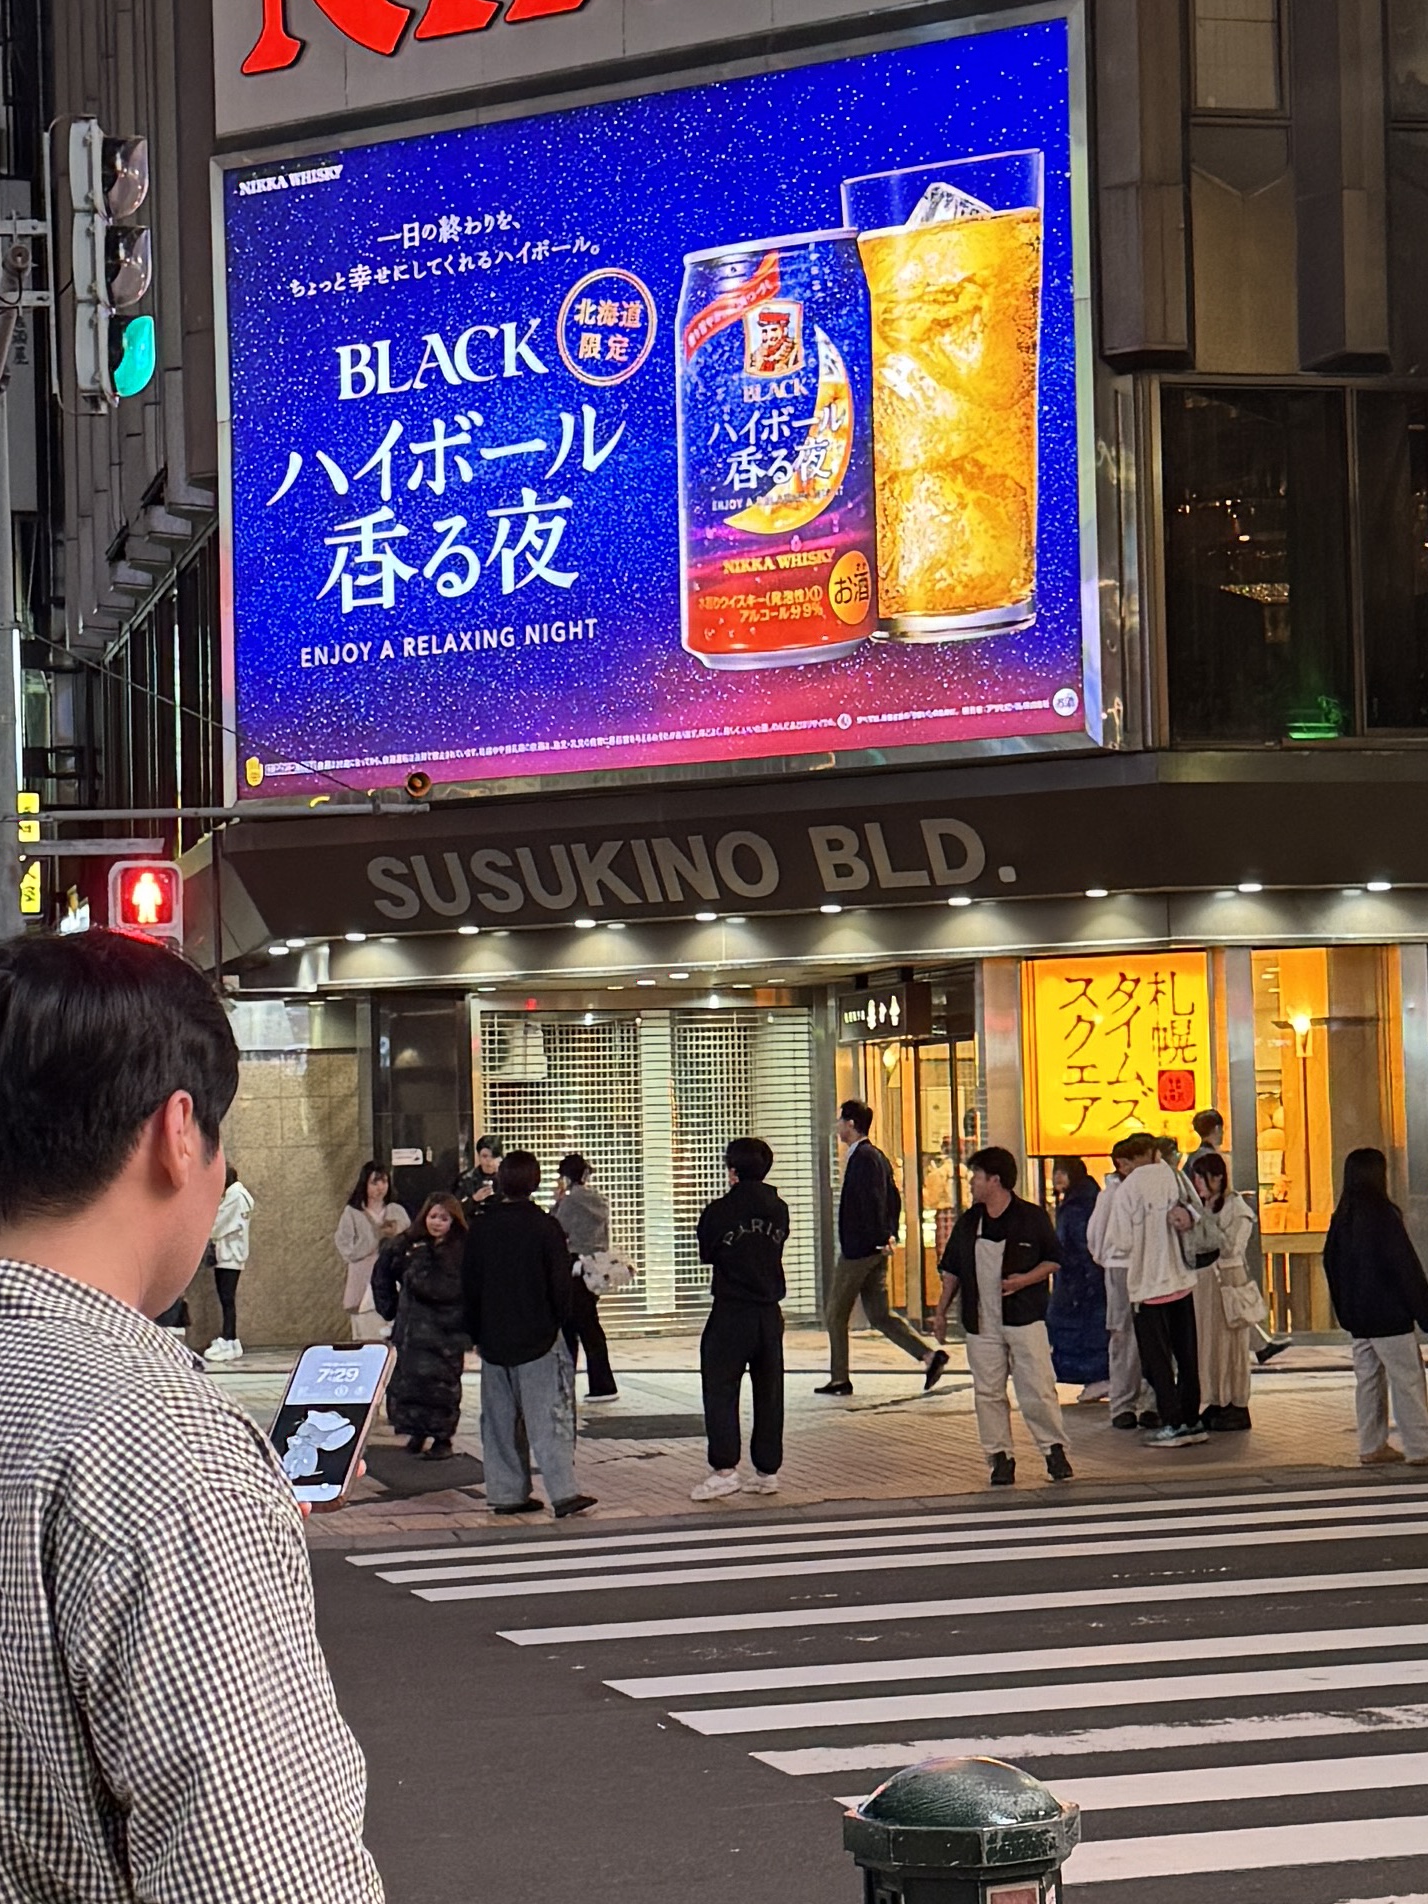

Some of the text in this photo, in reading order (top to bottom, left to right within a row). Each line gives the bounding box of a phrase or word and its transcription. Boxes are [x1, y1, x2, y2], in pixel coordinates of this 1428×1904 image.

[239, 164, 344, 196] NIKKA WHISKY
[376, 209, 521, 249] 一日の終わりを、
[289, 236, 601, 298] ちょっと幸せにしてくれるハイボール。
[574, 299, 644, 328] 北海道
[336, 317, 549, 400] BLACK
[578, 332, 630, 362] 限定
[743, 377, 809, 403] BLACK
[707, 403, 846, 446] ハイボール
[266, 403, 626, 507] ハイボール
[723, 439, 832, 492] 香る夜
[316, 487, 580, 614] 香る夜
[723, 548, 836, 575] NIKKA WHISKY
[834, 569, 870, 605] お酒
[301, 618, 598, 668] ENJOY A RELAXING NIGHT
[367, 818, 1017, 919] SUSUKINO BLD.
[1147, 971, 1197, 1066] 札幌
[1059, 977, 1102, 1136] スクエア
[1105, 972, 1154, 1132] タイムズ
[316, 1367, 360, 1383] 7:29
